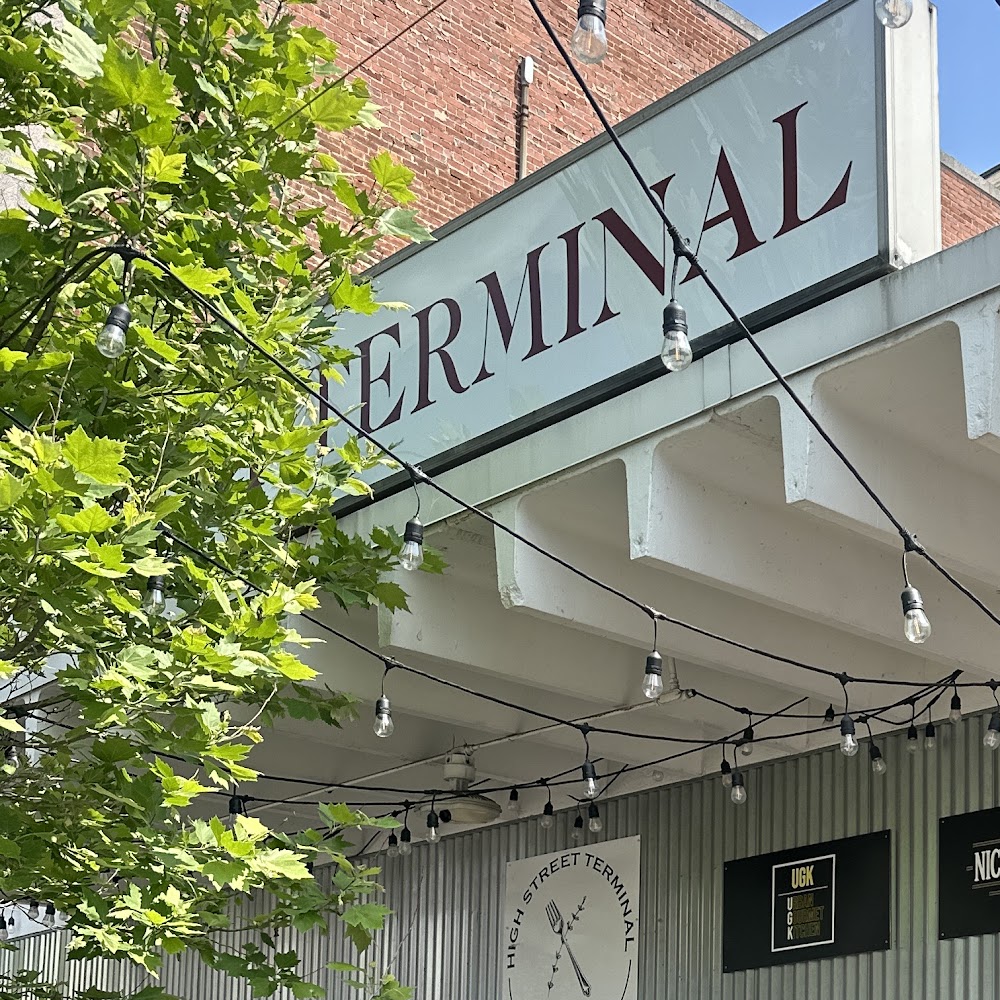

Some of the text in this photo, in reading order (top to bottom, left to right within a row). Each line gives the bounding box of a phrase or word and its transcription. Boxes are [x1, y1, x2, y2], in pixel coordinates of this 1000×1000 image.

[507, 852, 635, 969] HIGH STREET TERMINAL
[791, 865, 814, 889] UGK
